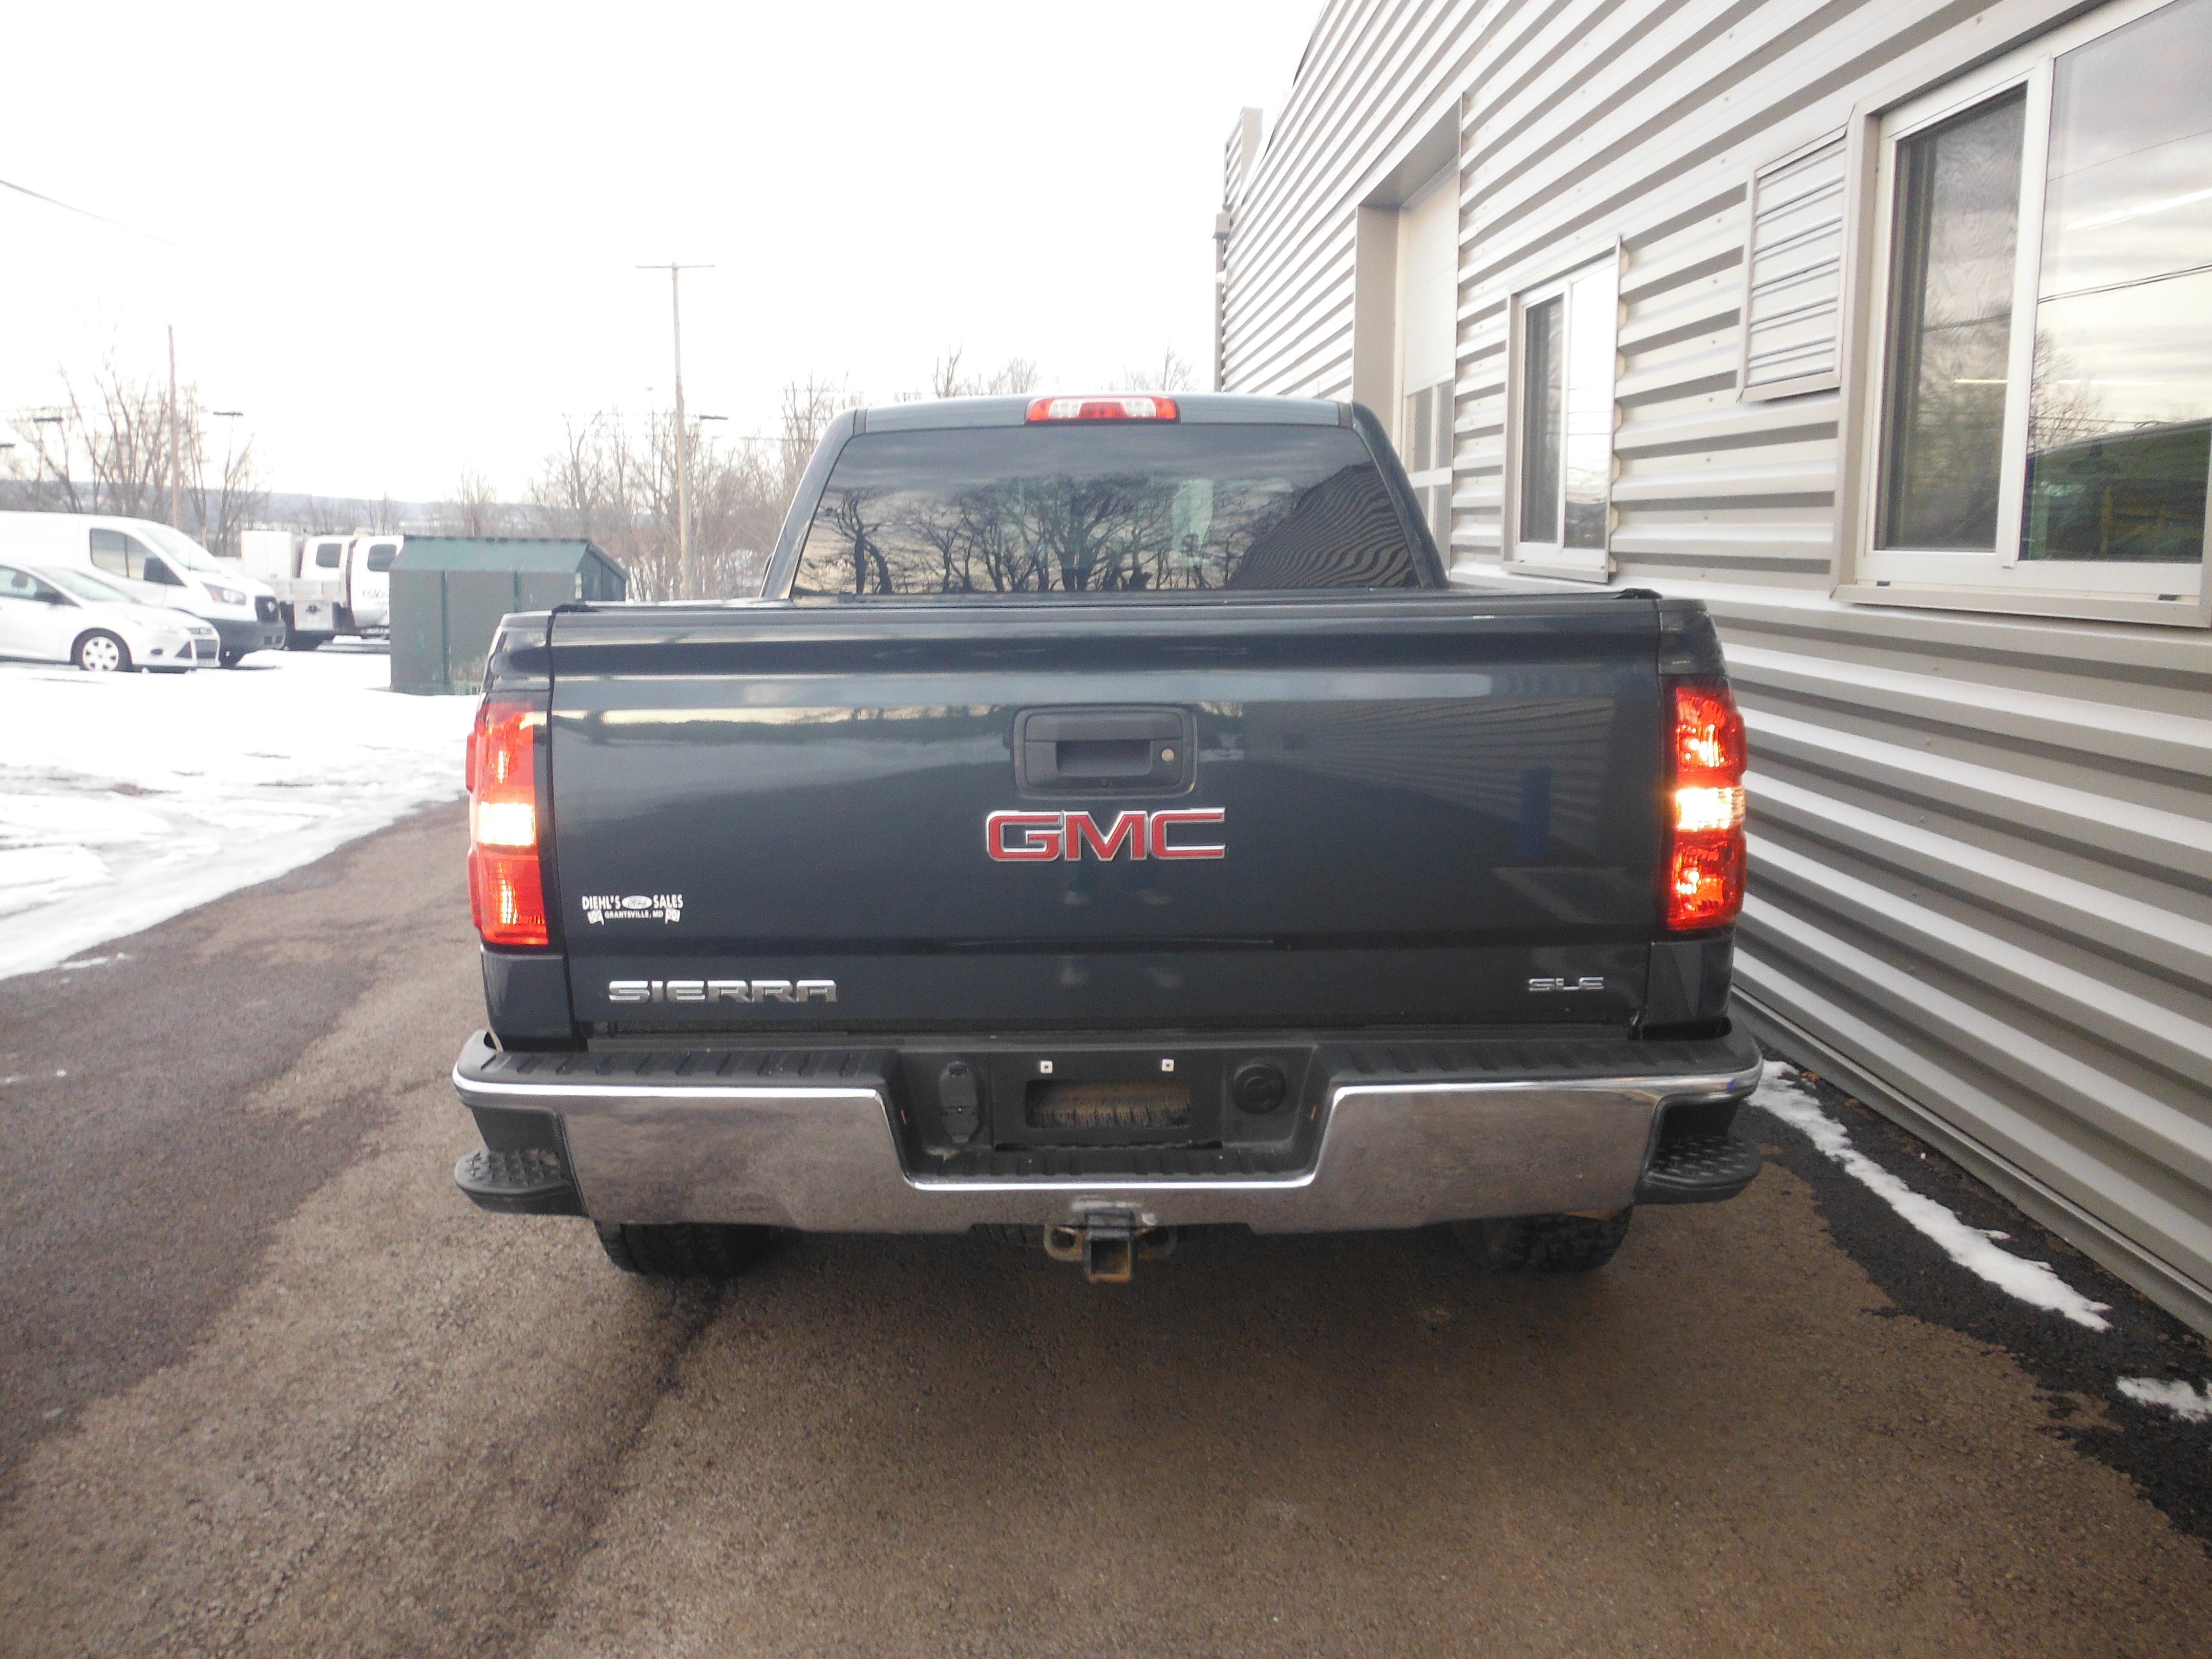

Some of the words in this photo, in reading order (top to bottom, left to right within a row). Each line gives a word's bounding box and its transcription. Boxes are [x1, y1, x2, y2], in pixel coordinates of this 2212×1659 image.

[986, 807, 1226, 861] GMC
[582, 896, 621, 910] DIEHL'S
[653, 894, 684, 909] SALES
[605, 910, 652, 919] GRANTSVILLE,
[652, 909, 664, 918] MD
[609, 980, 838, 1003] SIERRA
[1529, 977, 1604, 991] SLE
